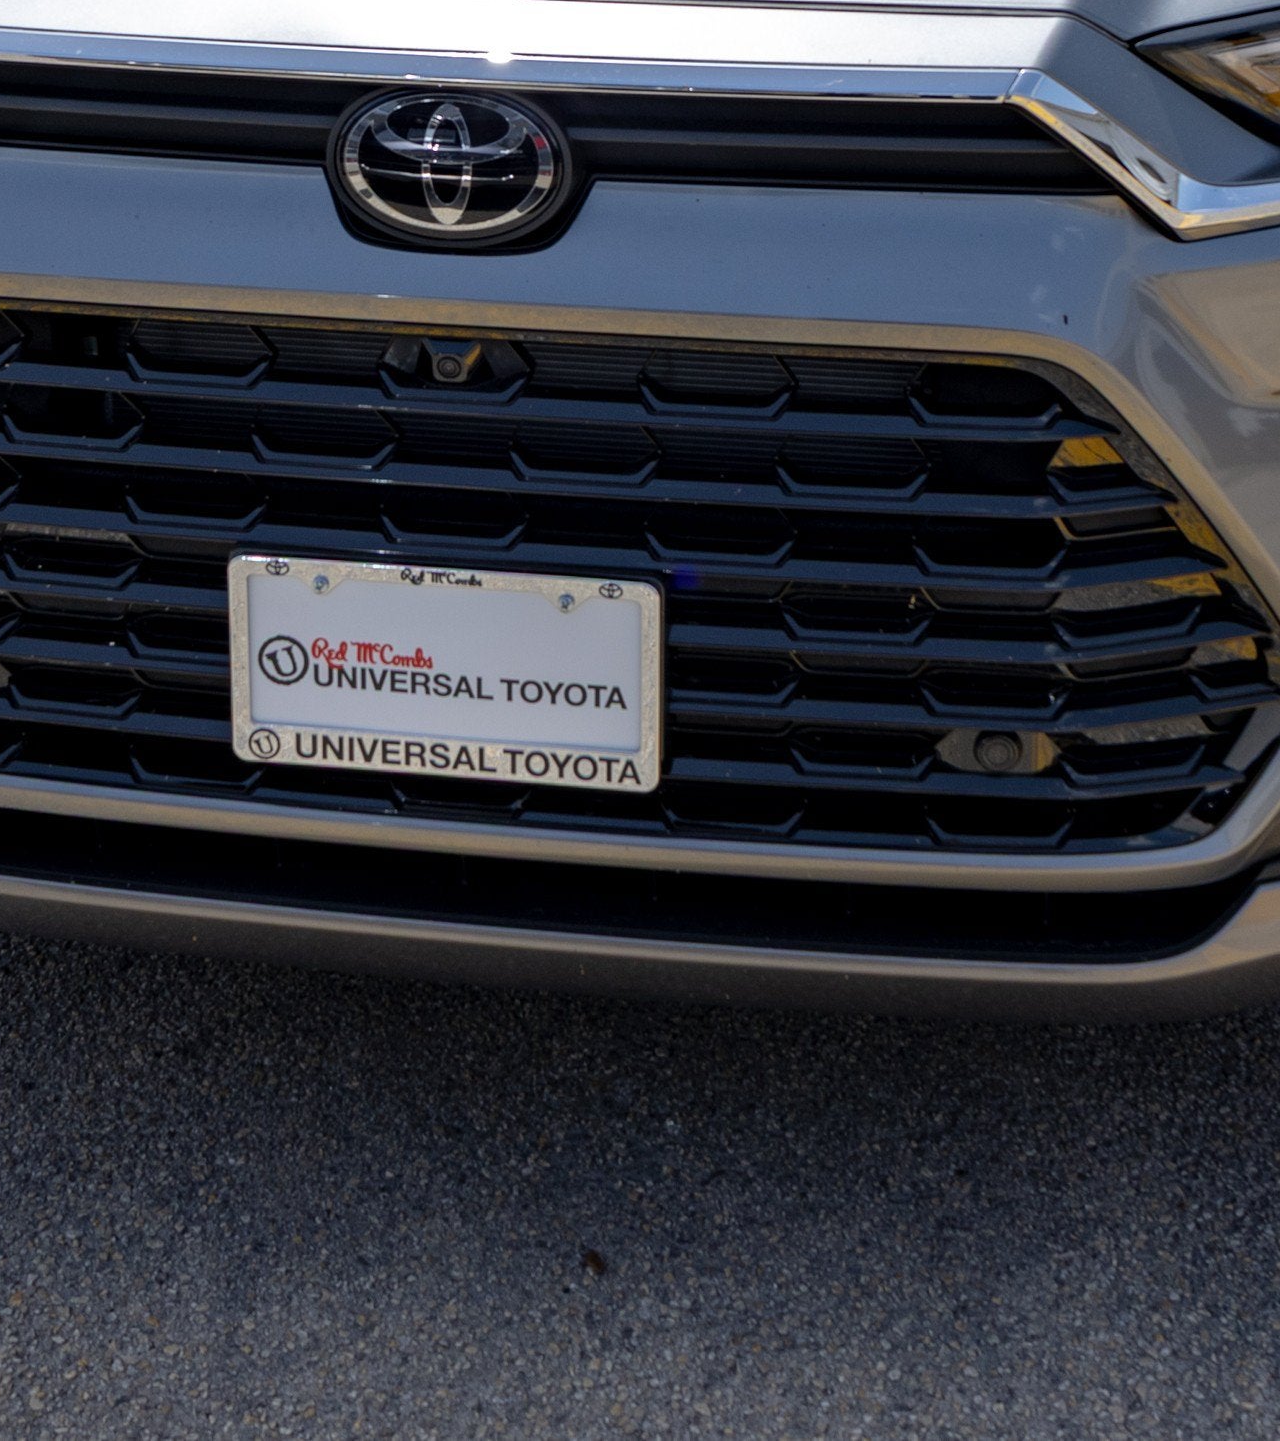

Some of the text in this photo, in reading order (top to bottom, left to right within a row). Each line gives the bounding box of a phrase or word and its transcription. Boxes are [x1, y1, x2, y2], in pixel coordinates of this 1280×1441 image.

[401, 568, 425, 585] Red
[311, 637, 433, 669] Red McCombs
[313, 663, 627, 709] UNIVERSAL TOYOTA
[295, 732, 497, 773] UNIVERSAL
[503, 748, 642, 785] TOYOTA
